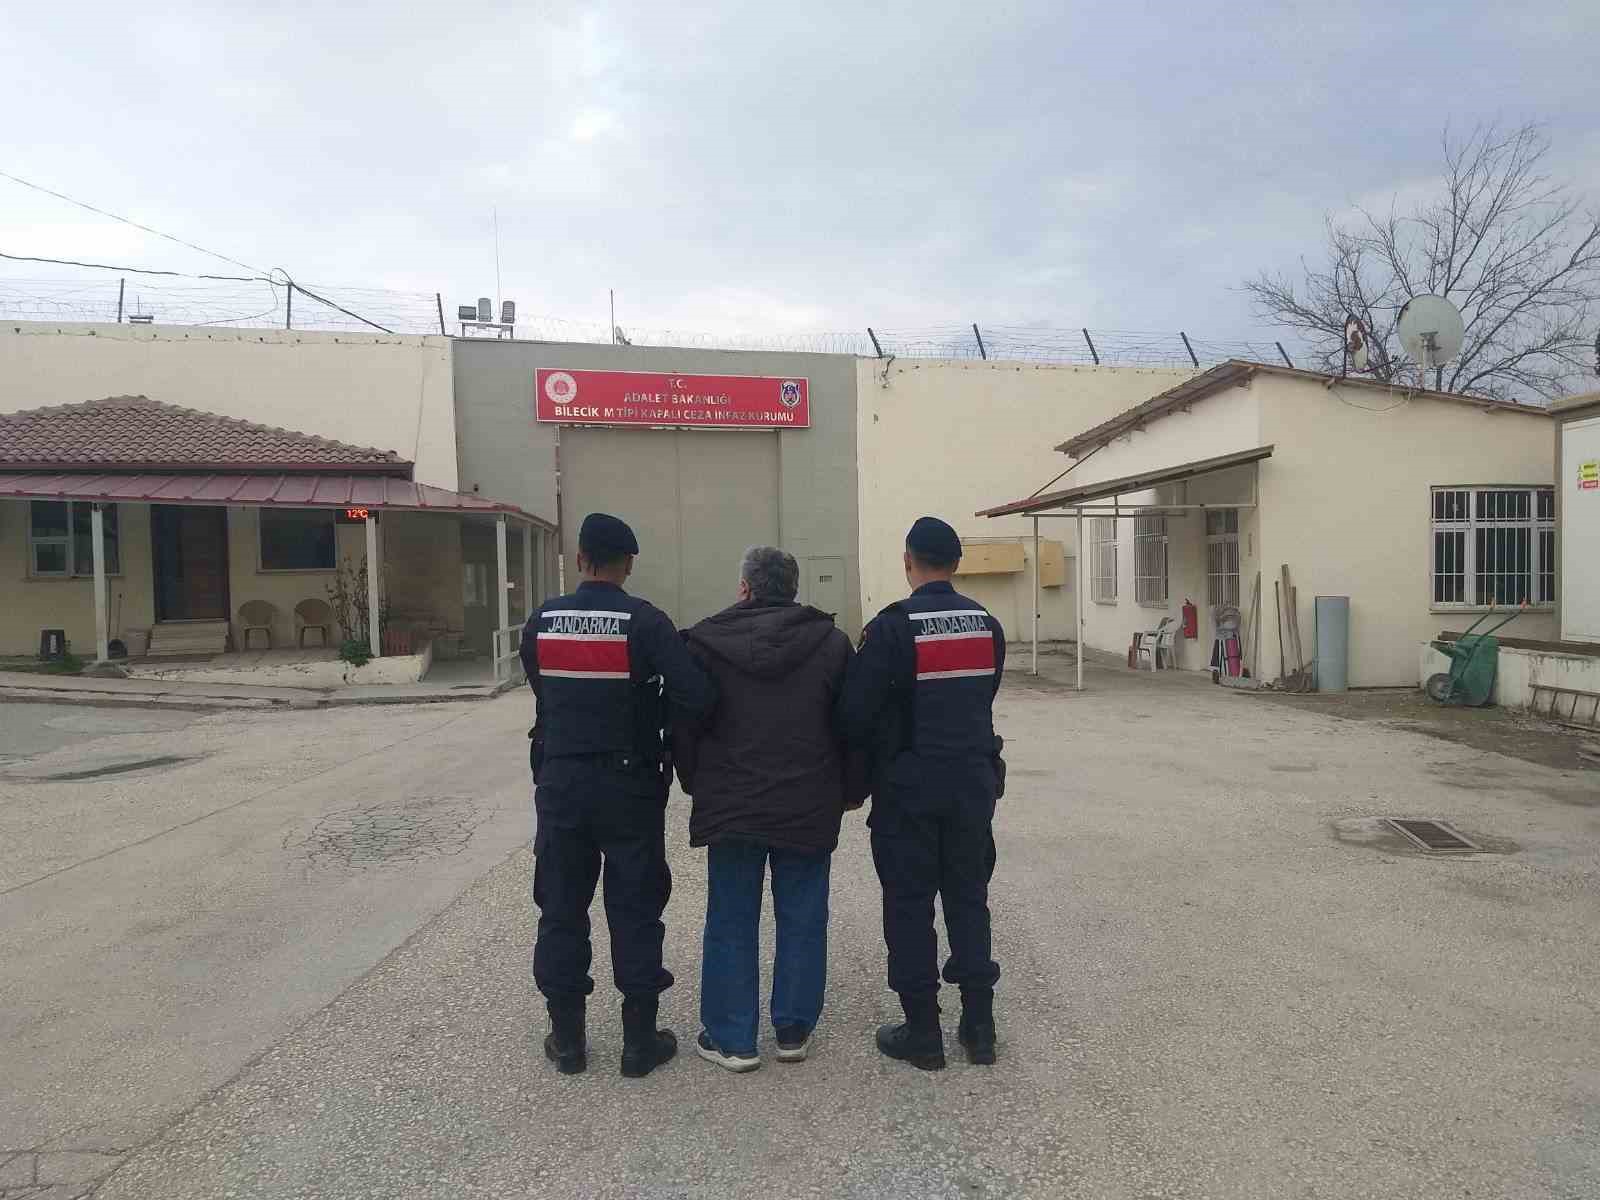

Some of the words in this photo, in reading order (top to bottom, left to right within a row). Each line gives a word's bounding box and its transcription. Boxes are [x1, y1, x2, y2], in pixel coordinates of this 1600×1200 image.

[623, 392, 669, 403] ADALET
[672, 393, 732, 405] BAKANLIĞI
[555, 404, 599, 417] BİLECİK
[604, 407, 614, 417] M
[641, 408, 682, 419] KAPALI
[684, 409, 712, 420] CEZA
[748, 410, 794, 421] KURUMU
[548, 616, 621, 634] JANDARMA
[920, 615, 987, 635] JANDARMA
